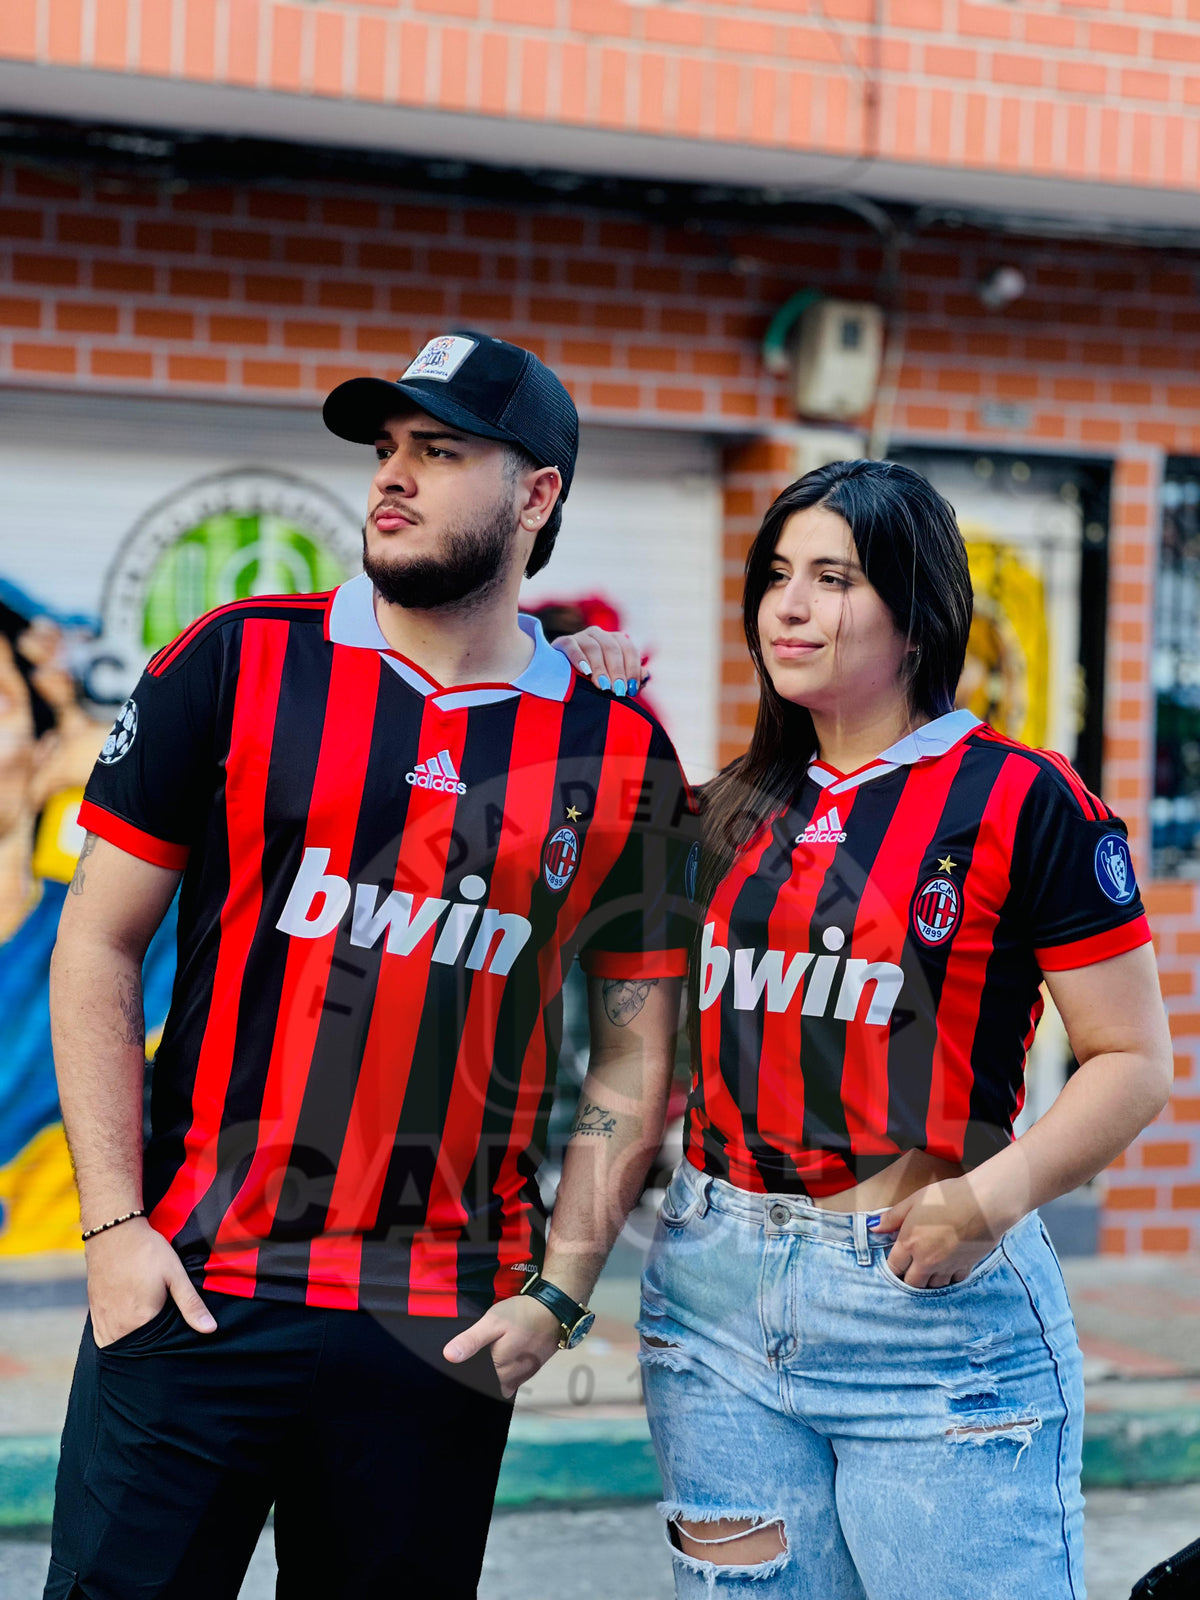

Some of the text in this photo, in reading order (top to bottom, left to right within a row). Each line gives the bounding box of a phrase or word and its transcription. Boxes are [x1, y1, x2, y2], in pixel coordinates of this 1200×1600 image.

[405, 770, 467, 795] adidas
[555, 830, 576, 848] ACM
[795, 829, 847, 843] adidas
[1107, 840, 1114, 855] 7
[548, 873, 563, 886] 1899
[928, 881, 954, 898] ACM
[276, 847, 532, 976] bwin
[921, 925, 942, 938] 1899
[699, 921, 905, 1026] bwin
